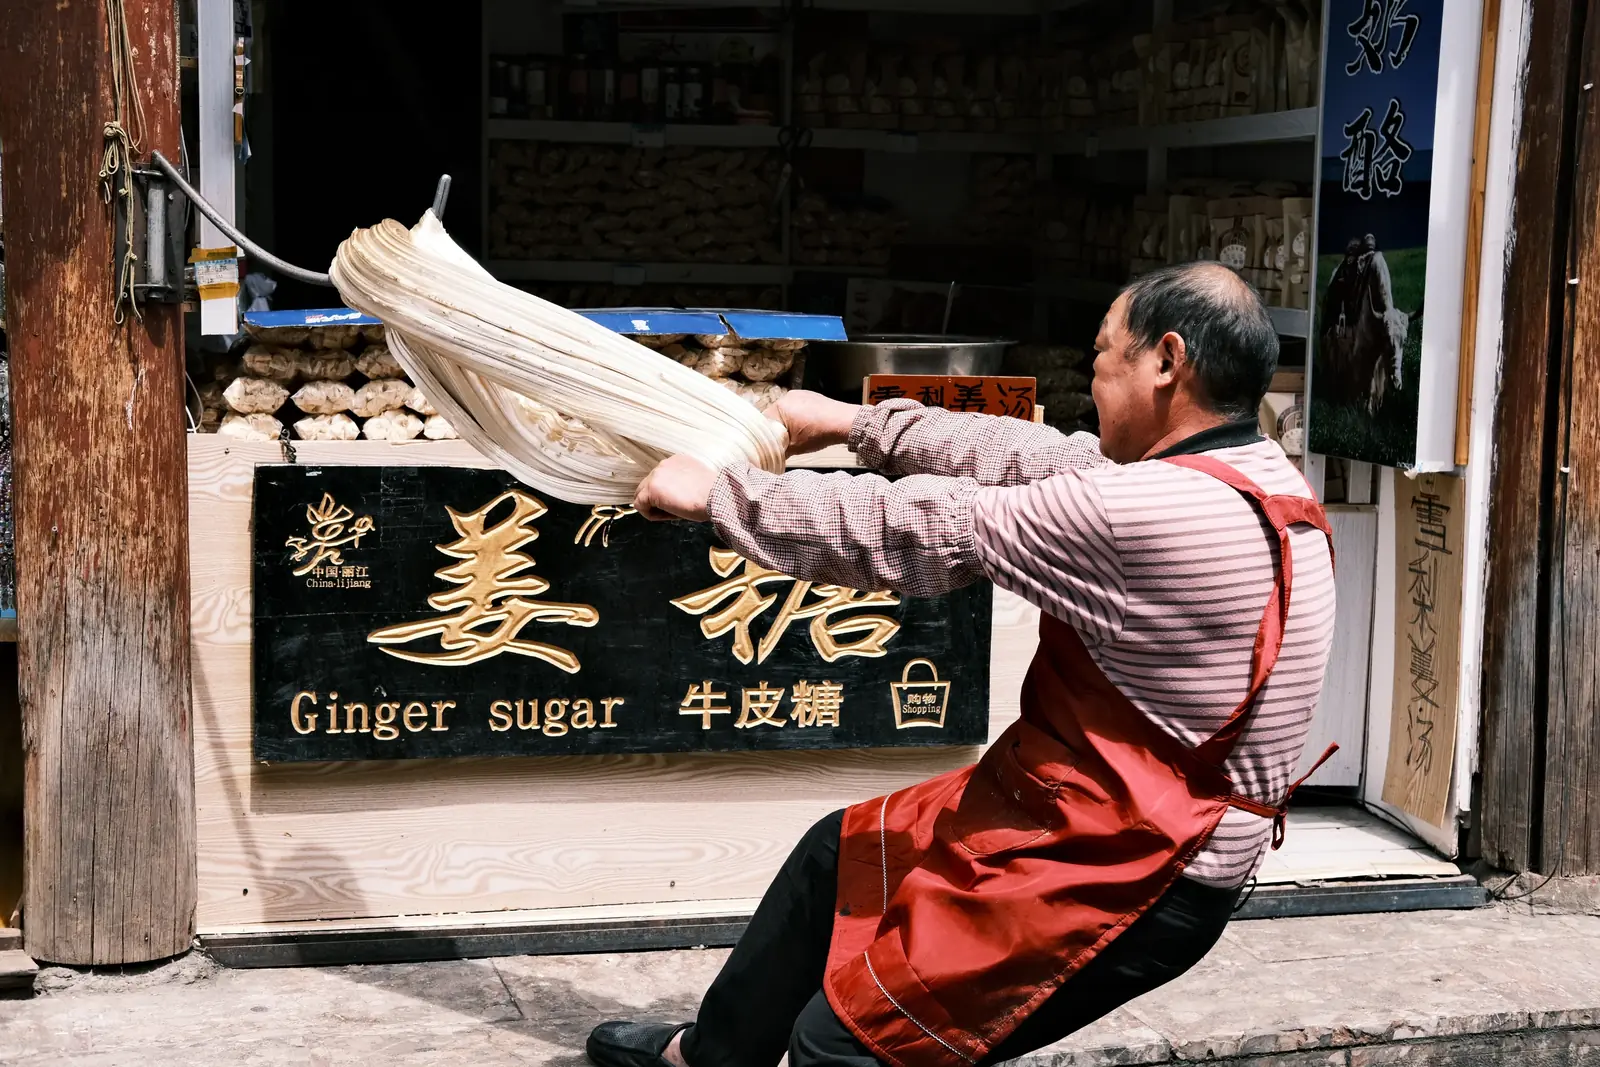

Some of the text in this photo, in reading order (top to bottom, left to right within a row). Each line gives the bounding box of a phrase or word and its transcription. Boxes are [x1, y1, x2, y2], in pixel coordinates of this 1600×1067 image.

[678, 680, 844, 729] 牛皮糖
[902, 704, 941, 715] Shopping
[907, 693, 937, 705] 购物
[290, 690, 625, 741] Ginger sugar
